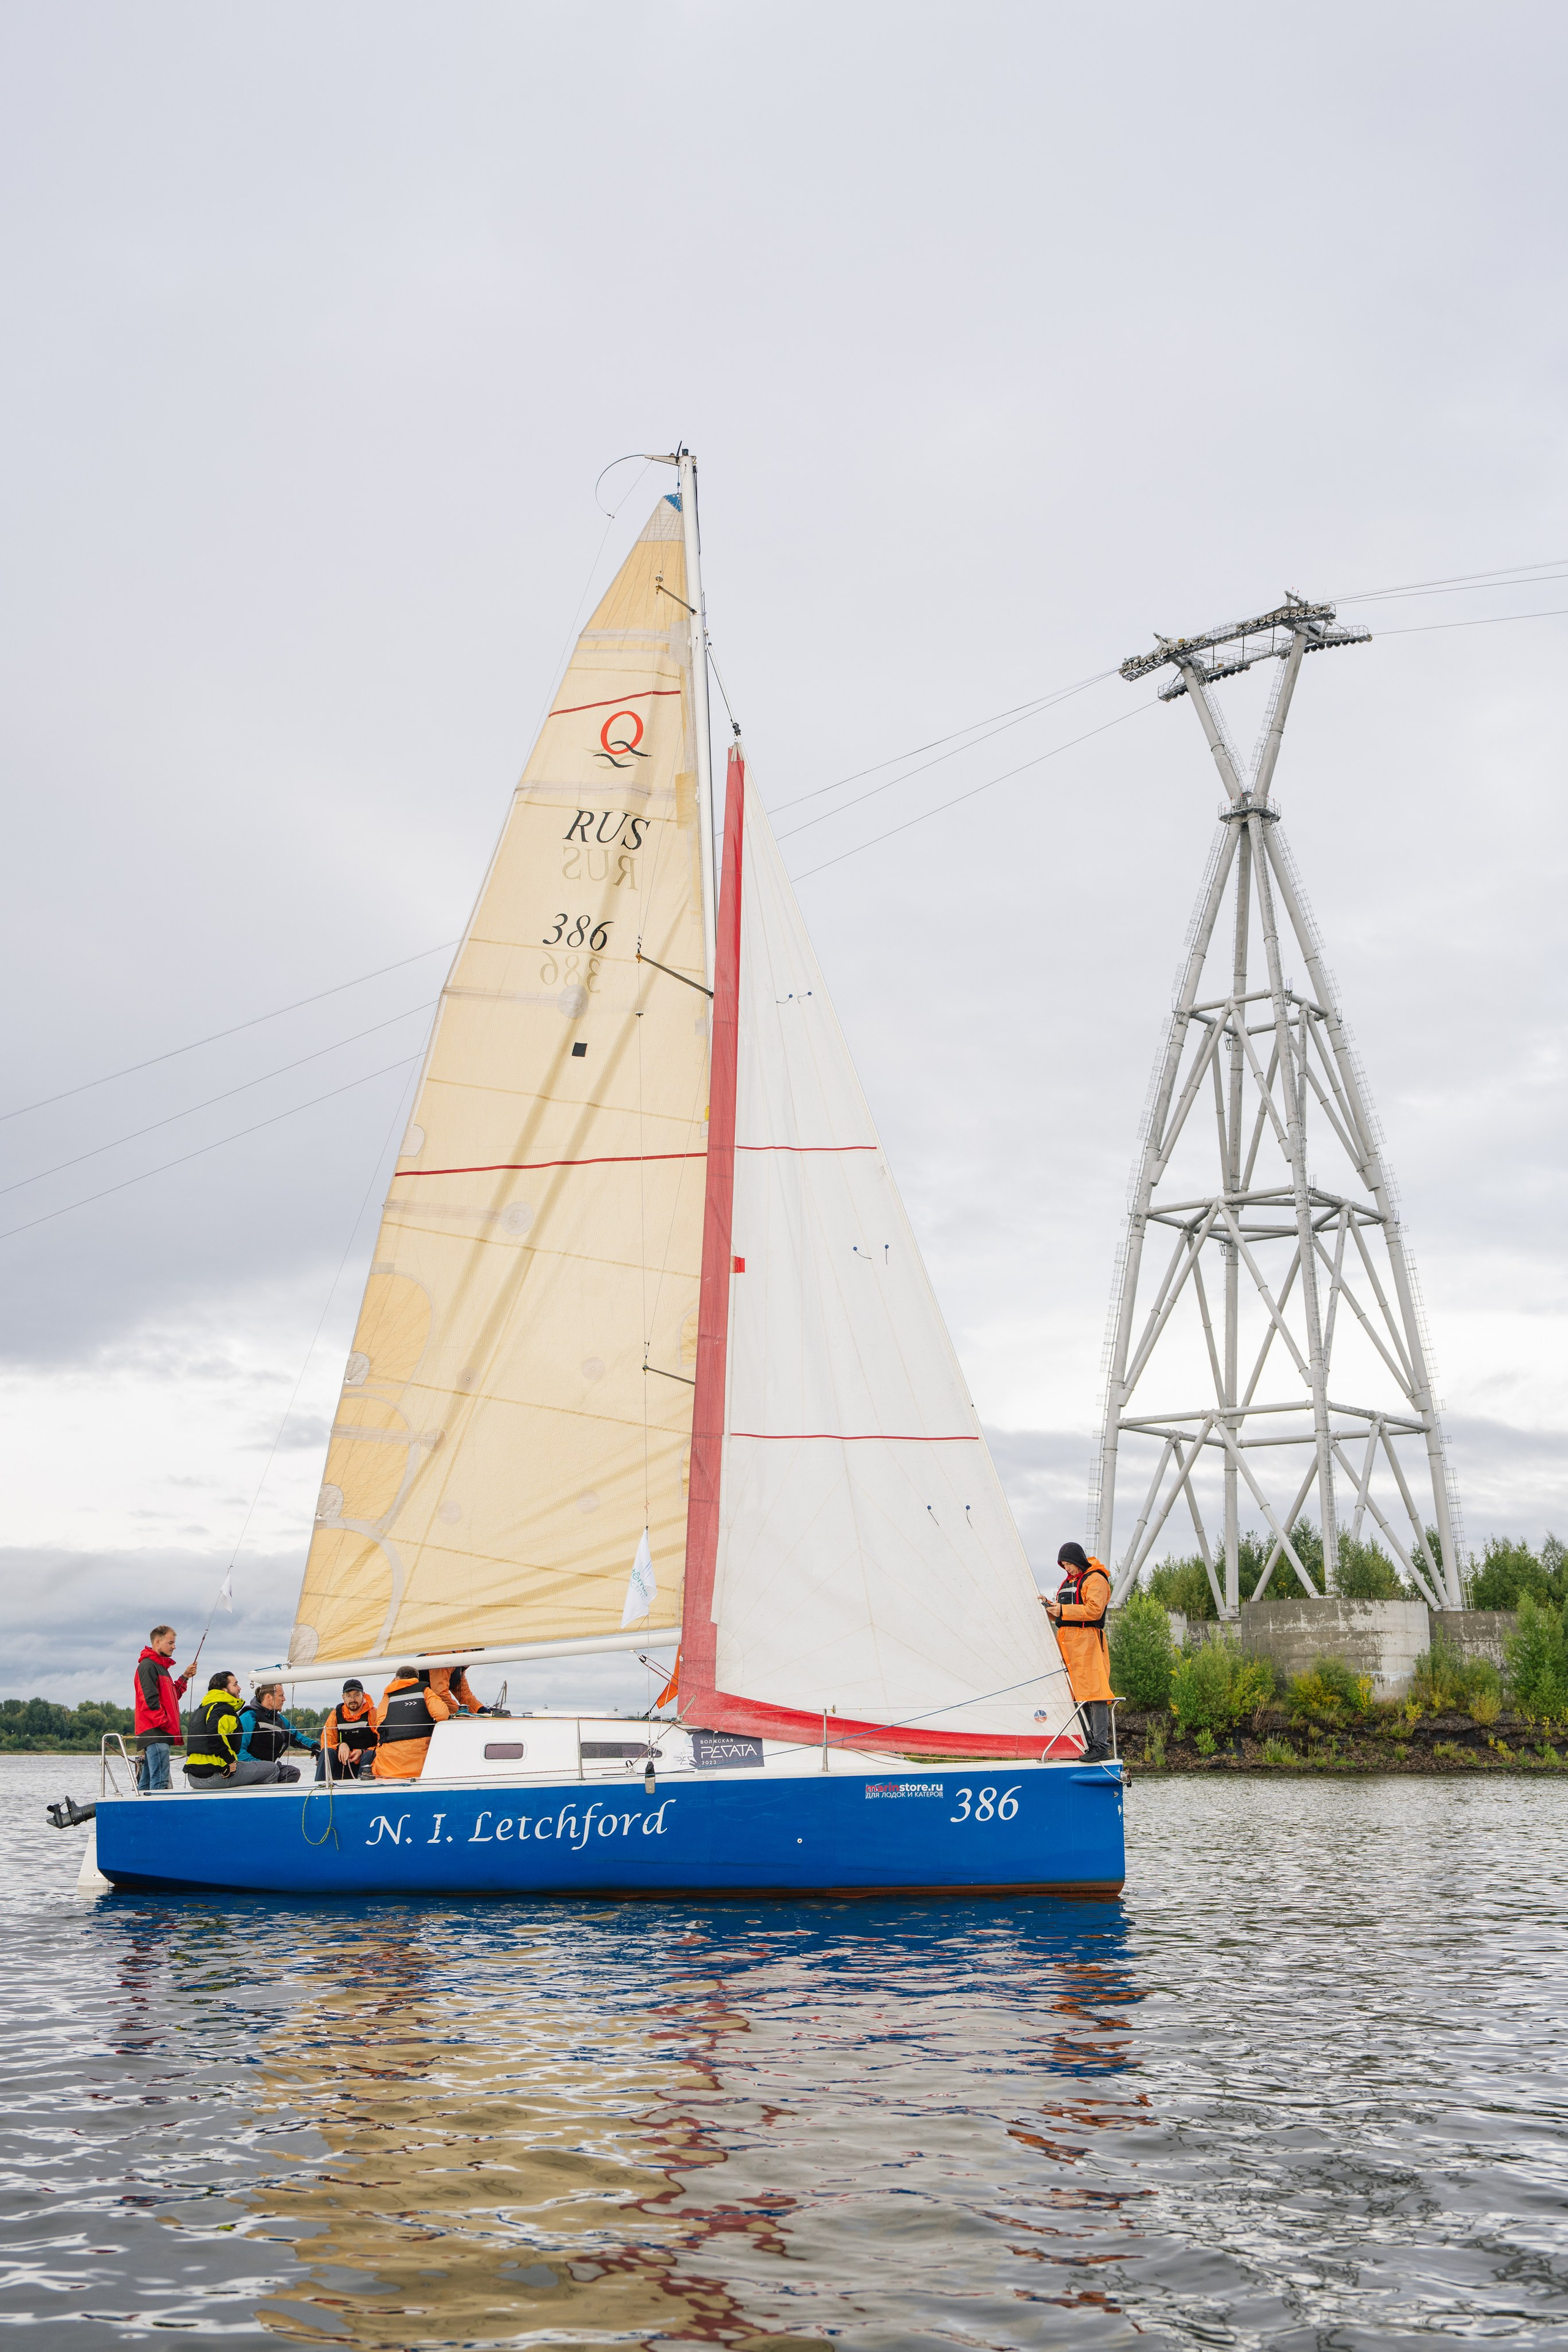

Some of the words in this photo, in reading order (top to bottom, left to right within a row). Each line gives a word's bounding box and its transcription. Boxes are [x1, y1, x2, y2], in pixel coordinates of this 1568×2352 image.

[562, 809, 652, 850] RUS
[542, 913, 614, 951] 386
[701, 1744, 758, 1759] РЕГАТА
[865, 1782, 943, 1792] marinstore.ru
[950, 1785, 1022, 1823] 386
[365, 1814, 413, 1845] N.
[426, 1813, 453, 1844] I.
[467, 1799, 677, 1850] Letchford
